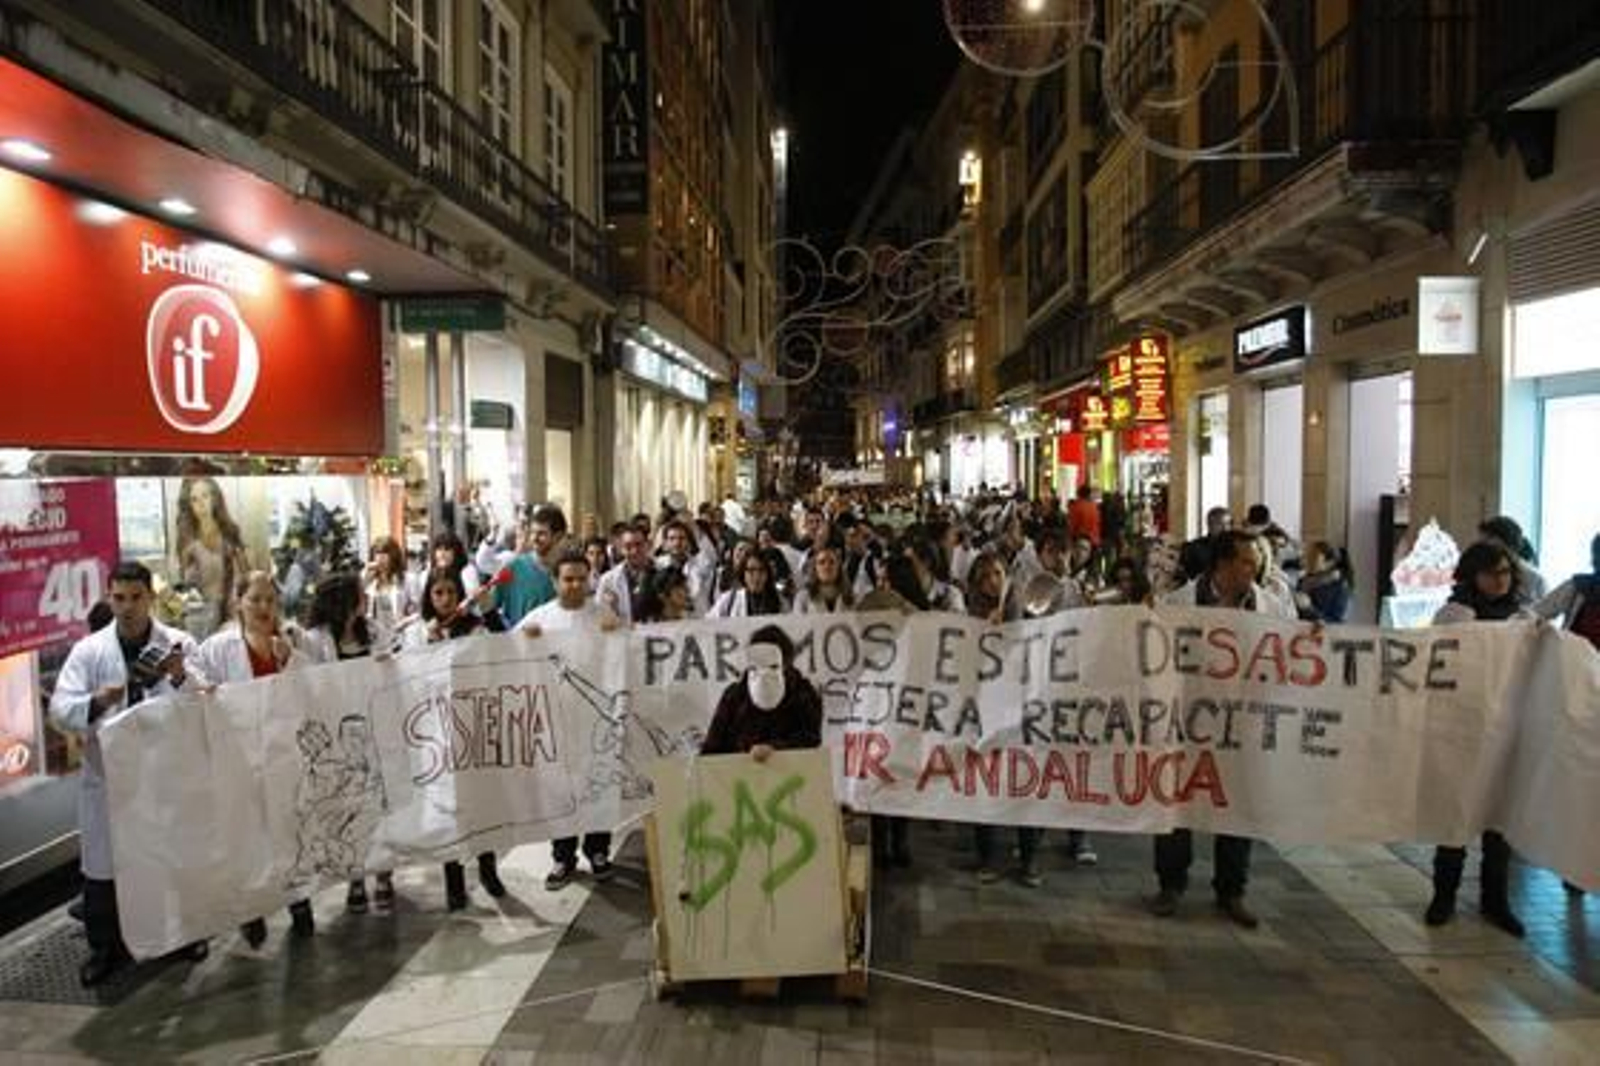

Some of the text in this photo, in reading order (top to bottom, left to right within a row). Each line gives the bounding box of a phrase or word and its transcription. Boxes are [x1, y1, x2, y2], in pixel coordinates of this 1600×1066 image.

[173, 314, 221, 412] if
[39, 557, 103, 622] 40
[643, 620, 1461, 695] PARMOS ESTE DESASTRE
[402, 684, 558, 787] SISTEMA
[1019, 697, 1342, 758] RECAPACITE
[680, 775, 818, 915] SAS
